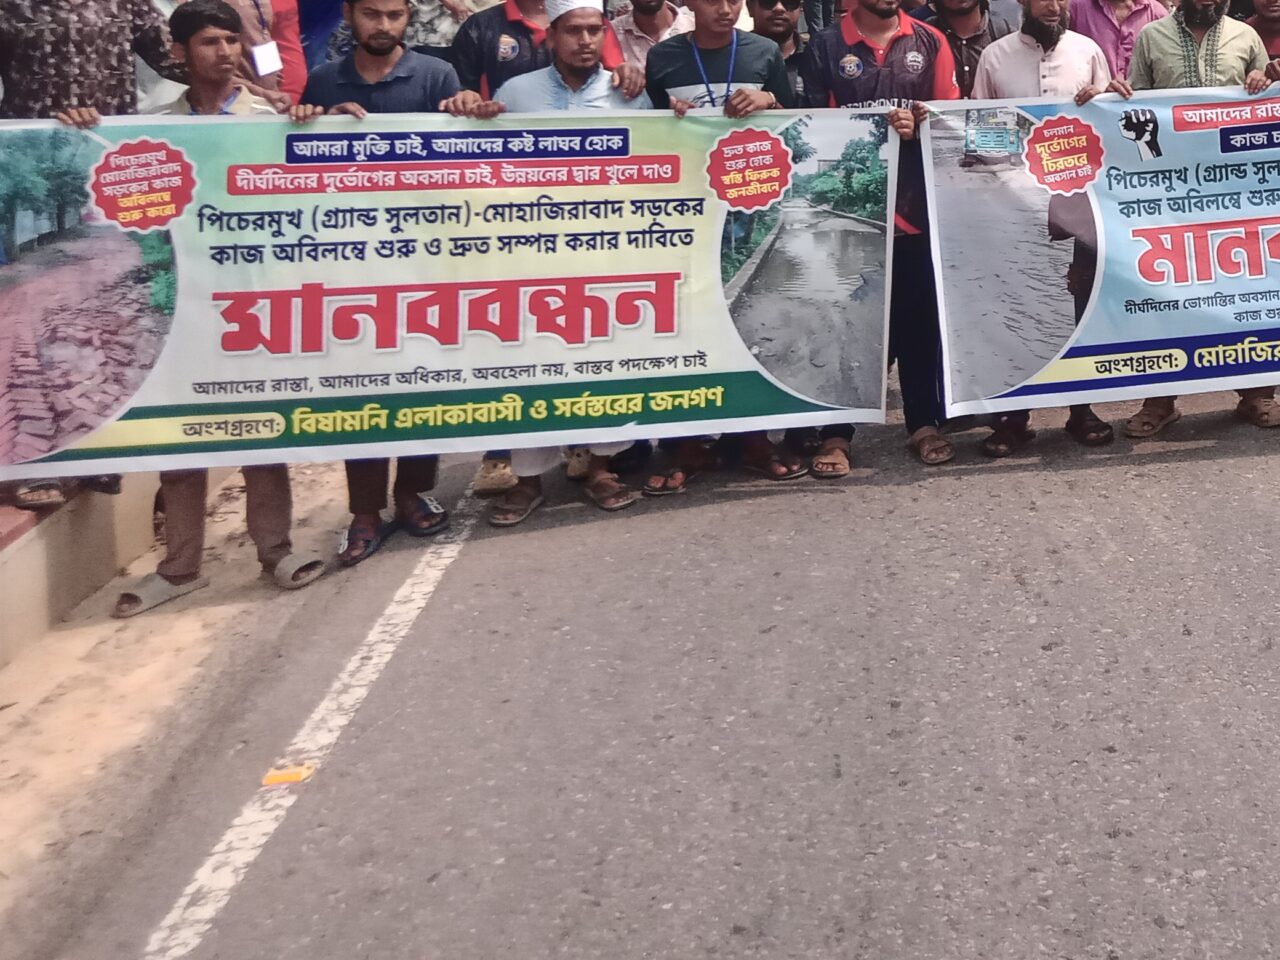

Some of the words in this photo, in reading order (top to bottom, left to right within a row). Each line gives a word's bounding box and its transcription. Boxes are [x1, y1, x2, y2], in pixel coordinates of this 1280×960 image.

[293, 141, 347, 158] আমরা
[352, 137, 390, 164] মুক্তি
[394, 137, 427, 158] চাই,
[432, 136, 502, 156] আমাদের
[508, 133, 533, 153] কষ্ট
[539, 135, 581, 151] লাঘব
[584, 131, 623, 151] হোক
[235, 167, 317, 191] দীর্ঘদিনের
[323, 165, 395, 192] দুর্ভোগের
[400, 167, 464, 189] অবসান
[468, 164, 497, 186] চাই,
[501, 162, 568, 184] উন্নয়নের
[572, 166, 601, 184] দ্বার
[607, 164, 638, 186] খুলে
[643, 164, 672, 179] দাও
[197, 205, 301, 237] পিচেরমুখ
[630, 196, 705, 223] সড়কের
[210, 244, 263, 266] কাজ
[272, 237, 366, 263] অবিলম্বে
[375, 239, 417, 258] শুরু
[425, 240, 441, 256] ও
[449, 235, 490, 257] দ্রুত
[498, 233, 557, 255] সম্পন্ন
[565, 230, 619, 252] করার
[627, 222, 694, 248] দাবিতে
[211, 271, 682, 355] মানববন্ধন
[1125, 297, 1179, 315] দীর্ঘদিনের
[1183, 293, 1235, 311] ভোগান্তির
[1240, 291, 1278, 304] অবসান
[1234, 310, 1262, 322] কাজ
[193, 379, 265, 395] আমাদের
[271, 377, 313, 394] রাস্তা,
[319, 374, 390, 390] আমাদের
[395, 367, 466, 386] অধিকার,
[472, 363, 536, 380] অবহেলা
[542, 362, 569, 379] নয়,
[574, 359, 612, 376] বাস্তব
[619, 356, 678, 372] পদক্ষেপ
[684, 350, 708, 368] চাই
[291, 404, 387, 434] বিষামনি
[394, 392, 524, 428] এলাকাবাসী
[529, 399, 548, 419] ও
[554, 391, 643, 417] সর্বস্তরের
[649, 385, 724, 410] জনগণ
